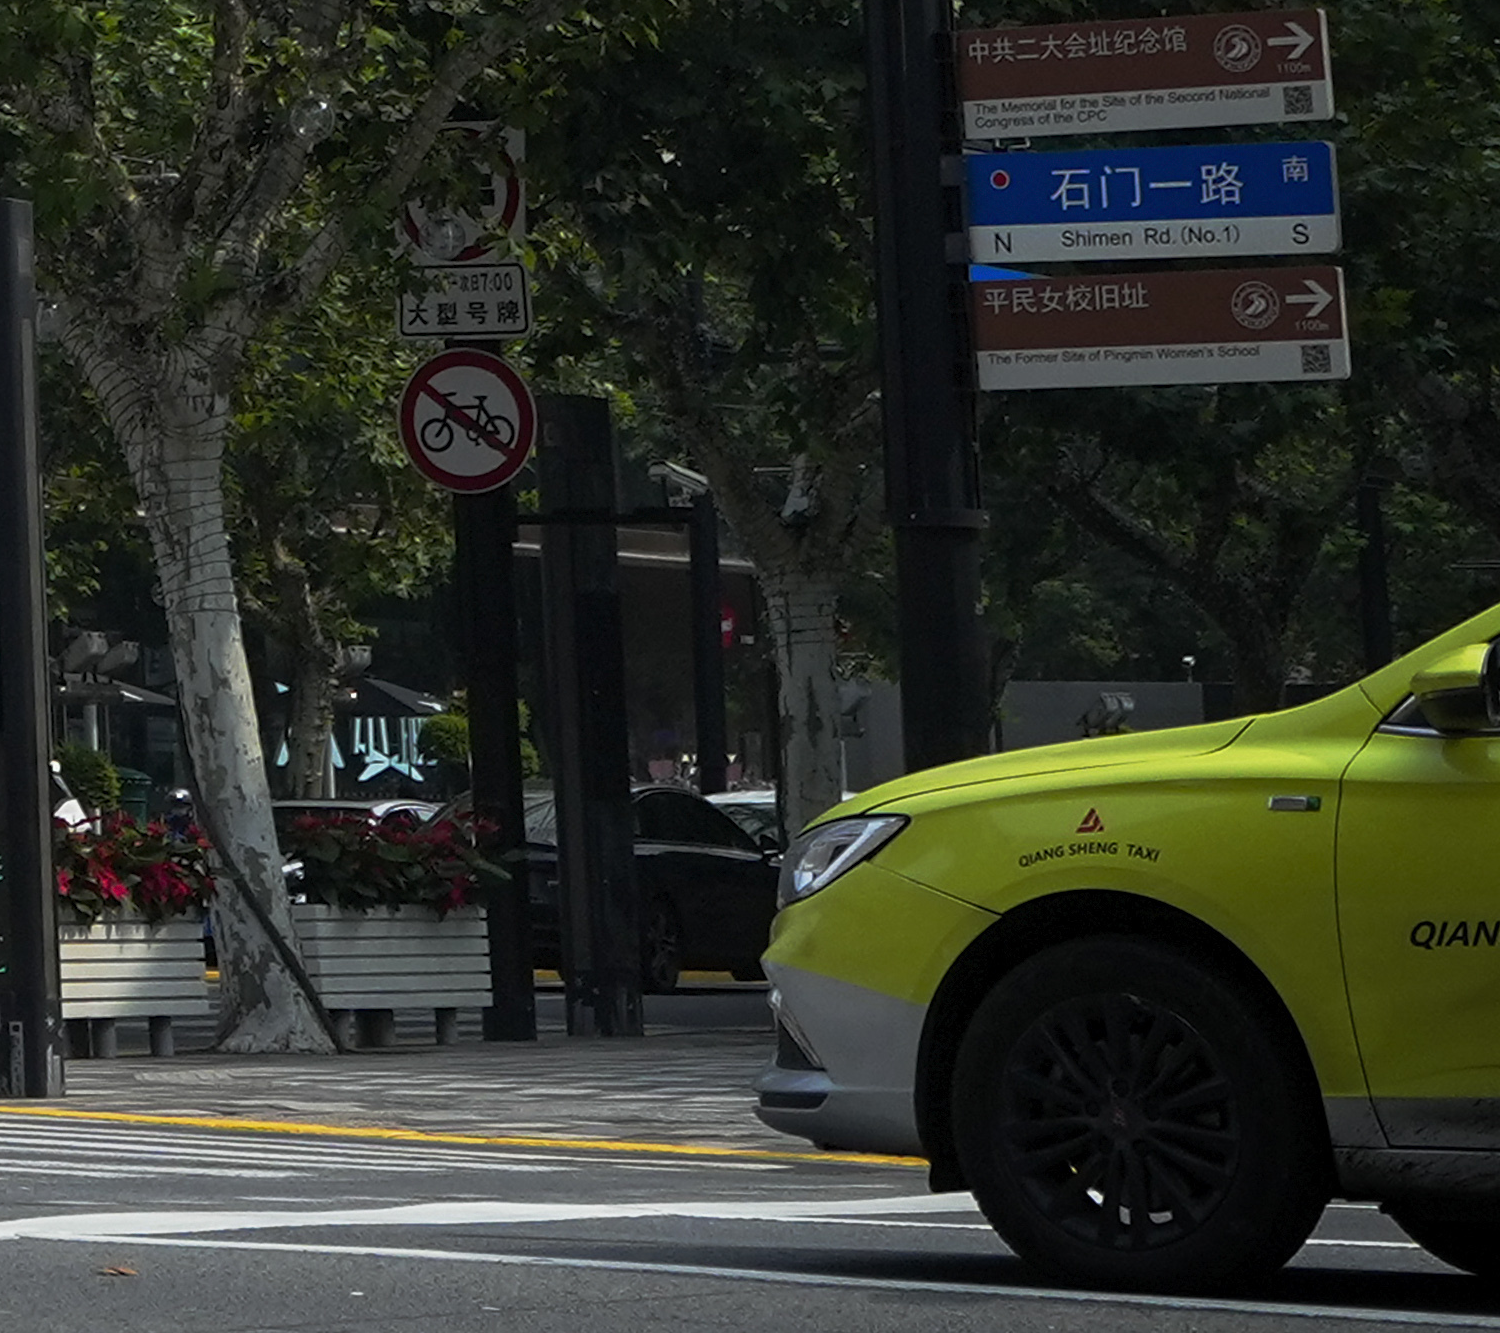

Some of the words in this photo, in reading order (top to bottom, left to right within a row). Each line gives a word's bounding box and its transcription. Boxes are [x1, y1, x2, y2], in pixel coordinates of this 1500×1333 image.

[968, 25, 1188, 65] 中共二大会址纪念馆
[975, 103, 998, 116] The
[1001, 99, 1057, 114] Memorial
[1060, 97, 1076, 110] for
[1079, 97, 1100, 110] the
[1129, 94, 1142, 106] of
[1144, 93, 1165, 106] the
[1168, 90, 1216, 105] Second
[975, 114, 1035, 131] Congress
[1037, 113, 1052, 126] of
[1053, 111, 1074, 125] the
[1077, 110, 1108, 124] CPC
[1050, 162, 1245, 211] 石门一路
[1281, 155, 1308, 183] 南
[994, 233, 1012, 254] N
[1061, 226, 1134, 249] Shimen
[1292, 223, 1310, 245] S
[982, 282, 1150, 315] 平民女校旧址
[407, 299, 521, 327] 大型号牌
[988, 354, 1012, 366] The
[1088, 349, 1101, 362] of
[1104, 348, 1155, 365] Pingmin
[1217, 345, 1261, 359] School
[1018, 843, 1065, 869] QIANG
[1068, 841, 1119, 857] SHENG
[1126, 843, 1161, 863] TAXI
